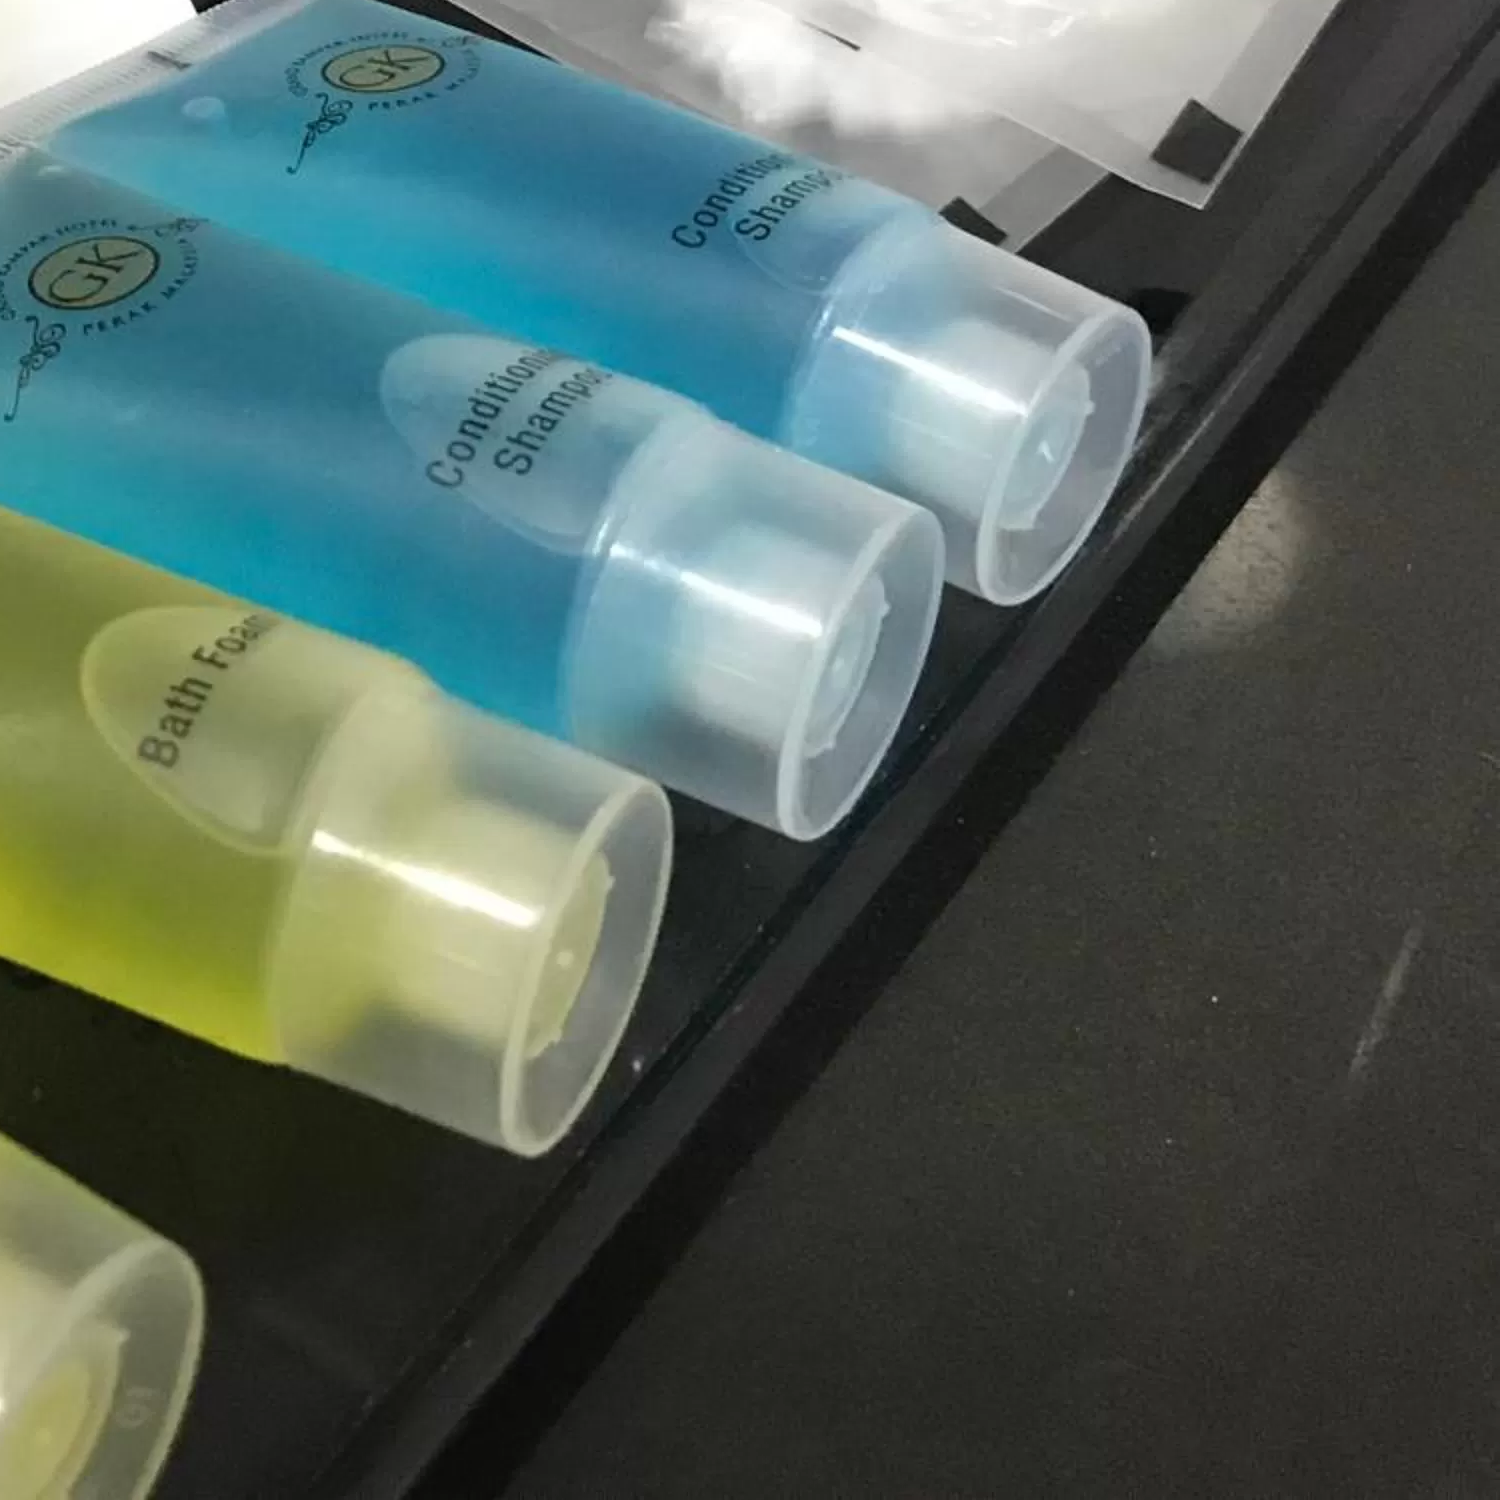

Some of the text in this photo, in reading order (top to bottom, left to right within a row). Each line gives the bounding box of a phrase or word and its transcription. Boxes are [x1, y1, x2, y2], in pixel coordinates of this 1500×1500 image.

[338, 48, 431, 88] GK
[48, 242, 142, 304] GK
[136, 675, 214, 769] Bath
